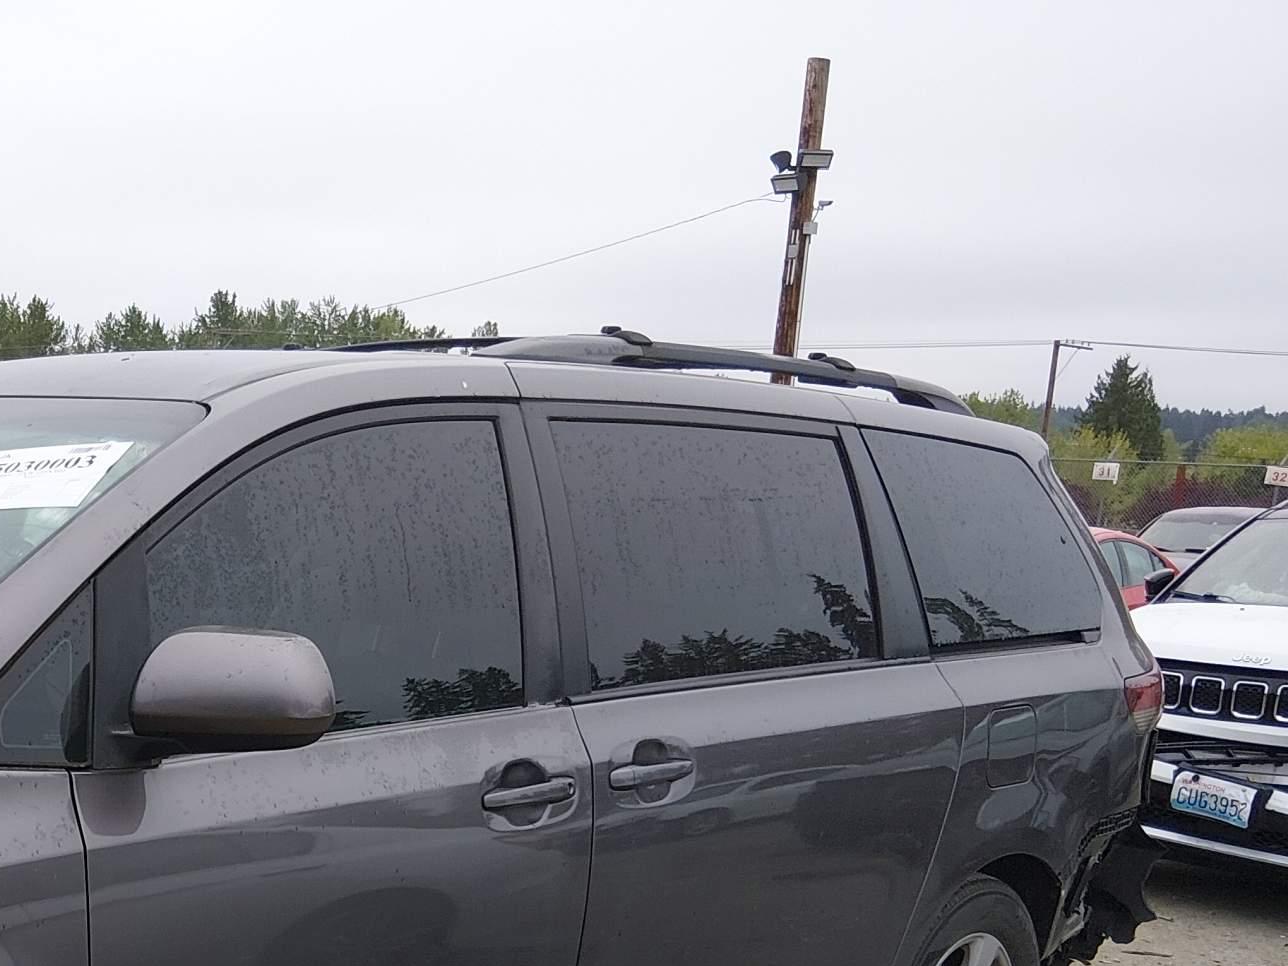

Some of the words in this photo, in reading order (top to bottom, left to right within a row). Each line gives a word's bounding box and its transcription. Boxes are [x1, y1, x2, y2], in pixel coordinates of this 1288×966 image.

[1097, 466, 1111, 477] 31
[1272, 471, 1288, 483] 32
[1231, 650, 1273, 666] Jeep
